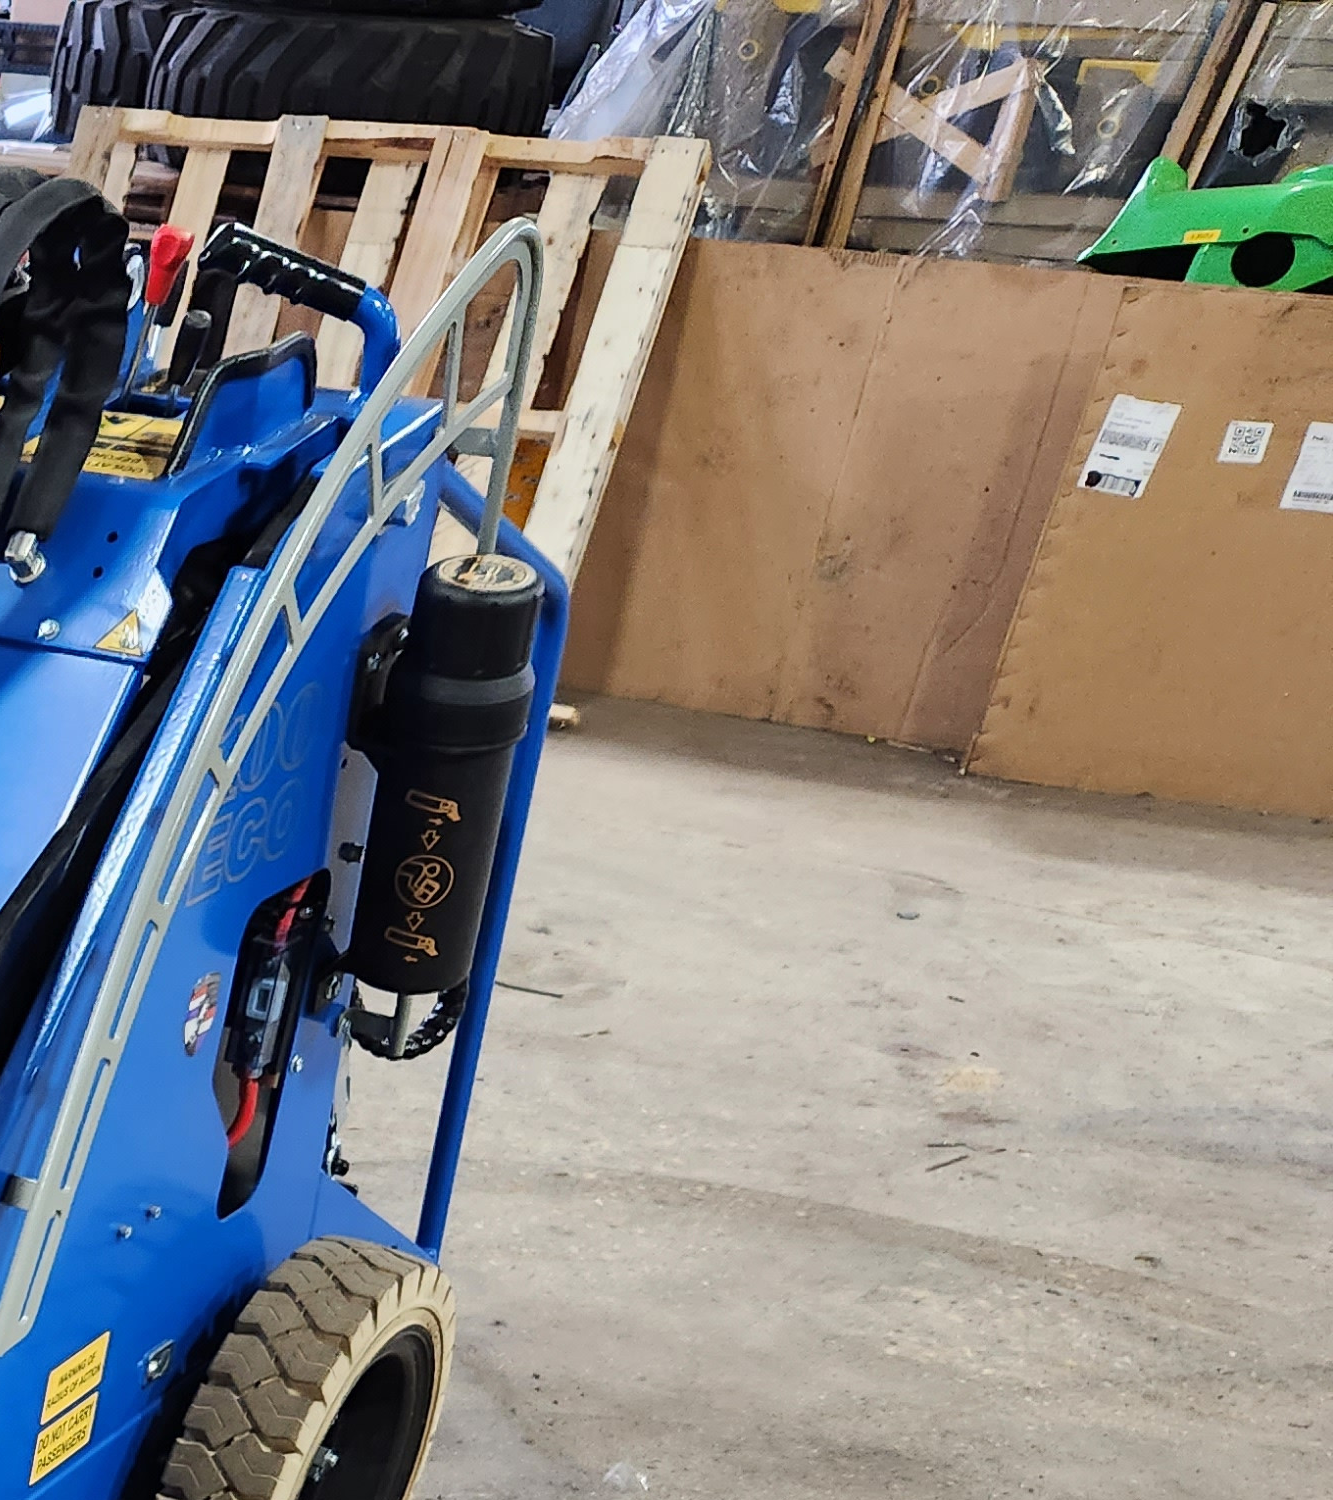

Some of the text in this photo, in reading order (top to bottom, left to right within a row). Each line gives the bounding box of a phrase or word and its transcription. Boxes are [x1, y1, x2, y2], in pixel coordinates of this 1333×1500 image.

[79, 1362, 101, 1388] ACTION
[36, 1425, 87, 1474] PASSENGERS
[37, 1400, 94, 1454] DO NOT CARRY
